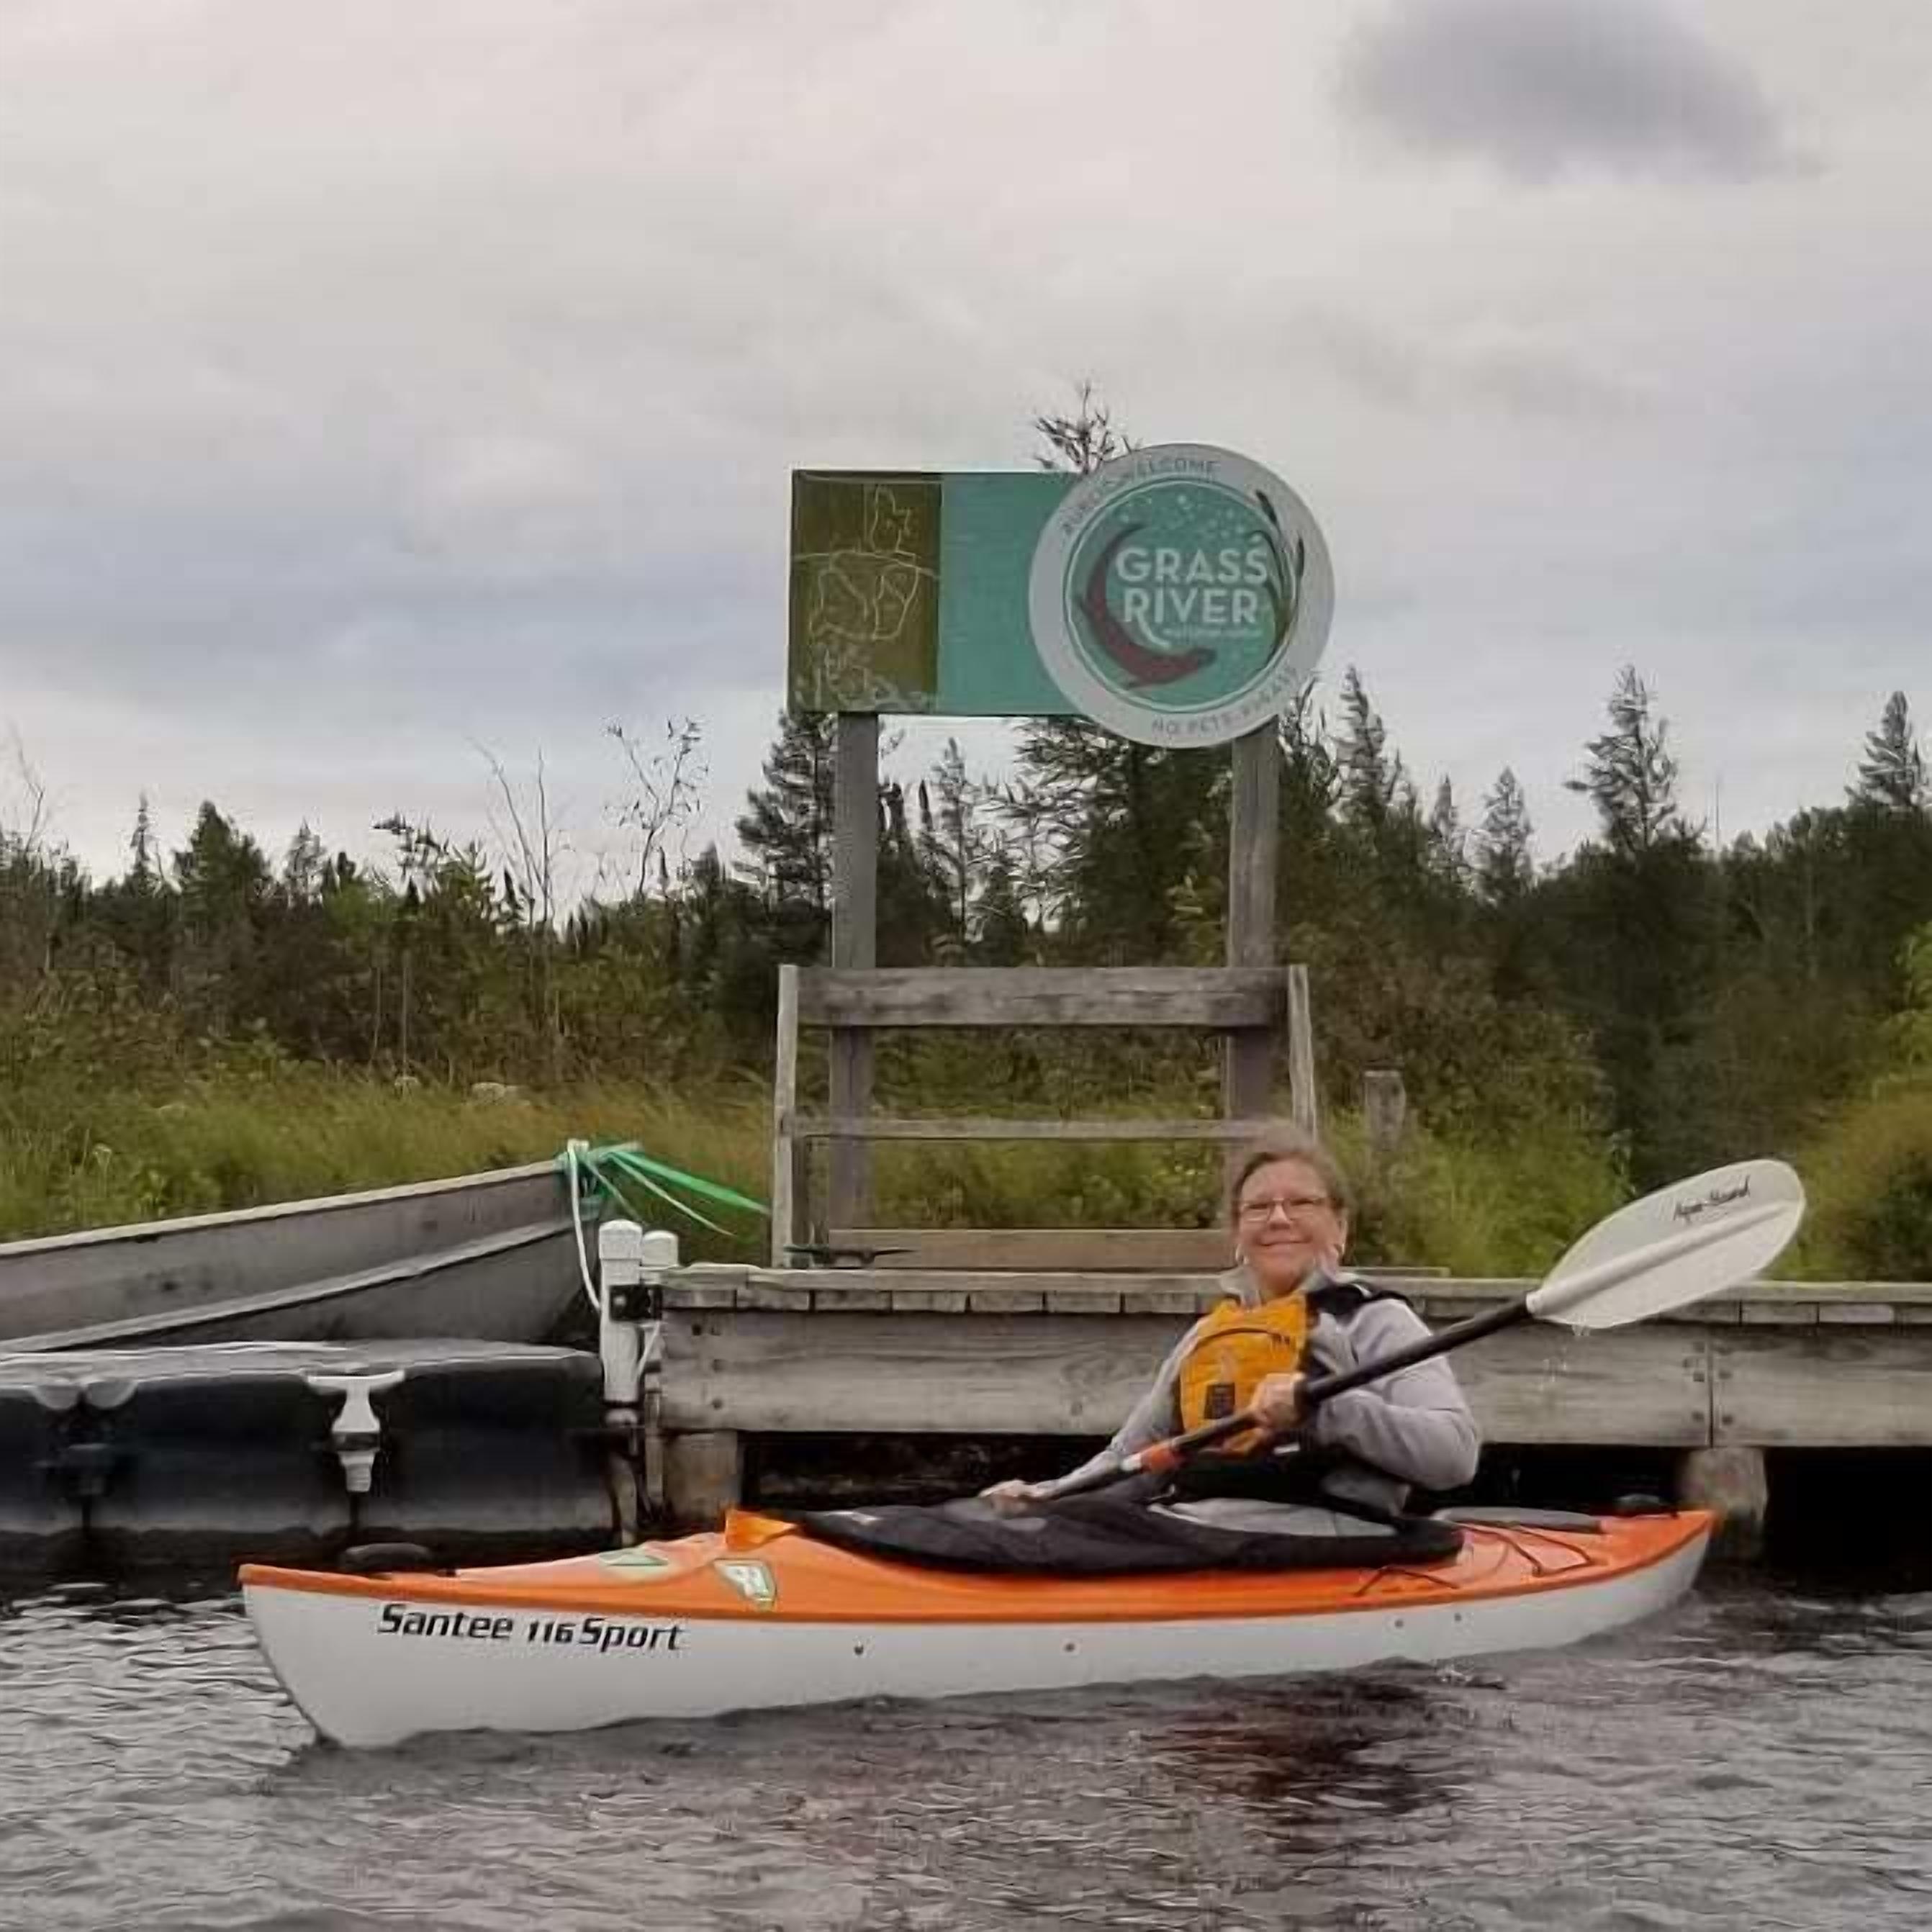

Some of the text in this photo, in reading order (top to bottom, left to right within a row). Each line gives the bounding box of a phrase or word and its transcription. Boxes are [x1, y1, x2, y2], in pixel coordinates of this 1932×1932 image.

[1116, 546, 1268, 584] GRASS
[1123, 588, 1259, 646] RIVER
[377, 1603, 686, 1652] Santee 116 Sport
